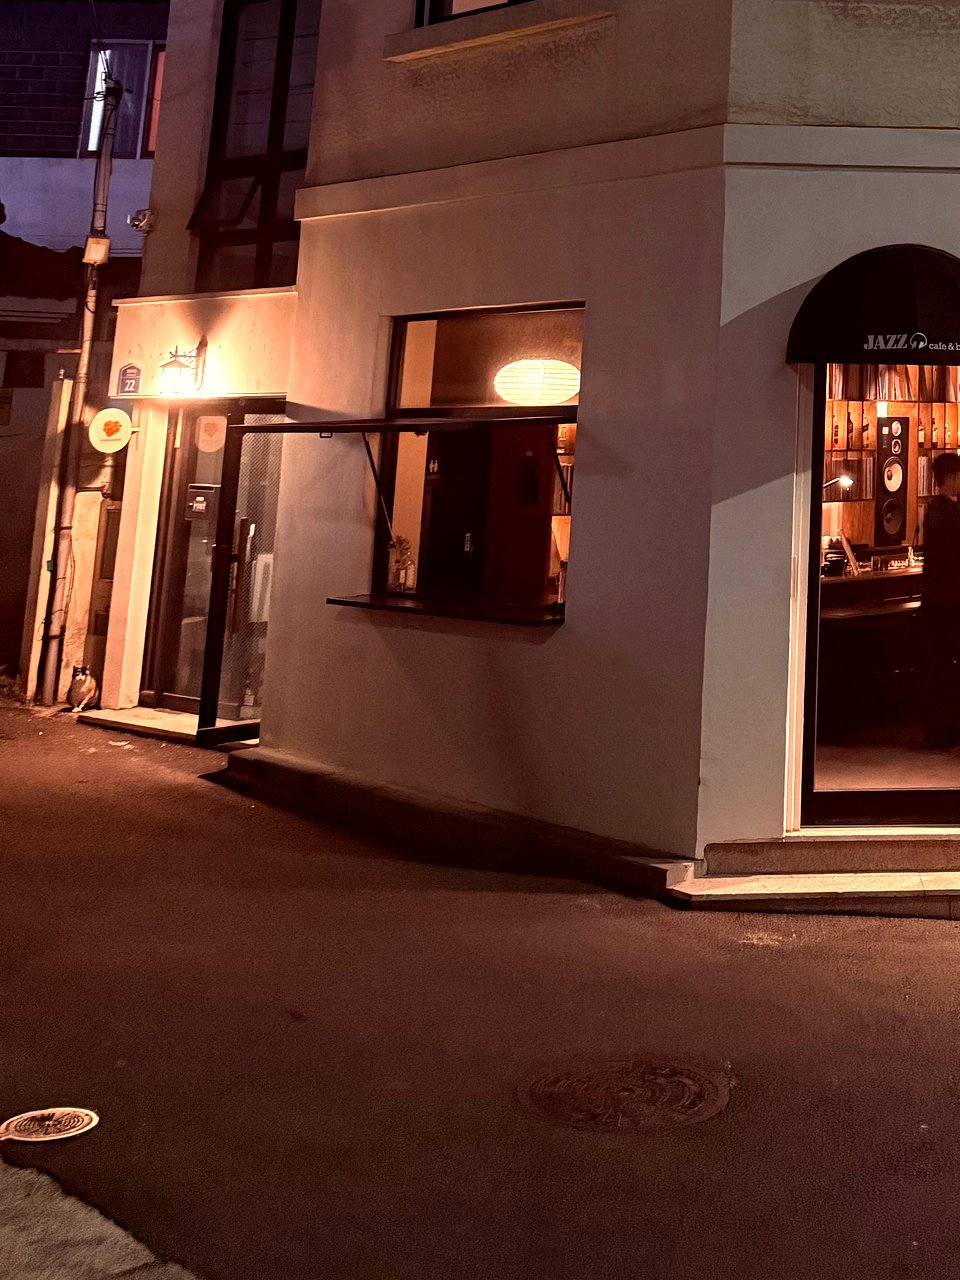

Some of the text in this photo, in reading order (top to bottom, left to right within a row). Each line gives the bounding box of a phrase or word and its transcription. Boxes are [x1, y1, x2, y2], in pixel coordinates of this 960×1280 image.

[863, 334, 908, 350] JAZZ
[928, 341, 947, 350] cafe
[948, 342, 955, 351] &
[125, 379, 136, 391] 22
